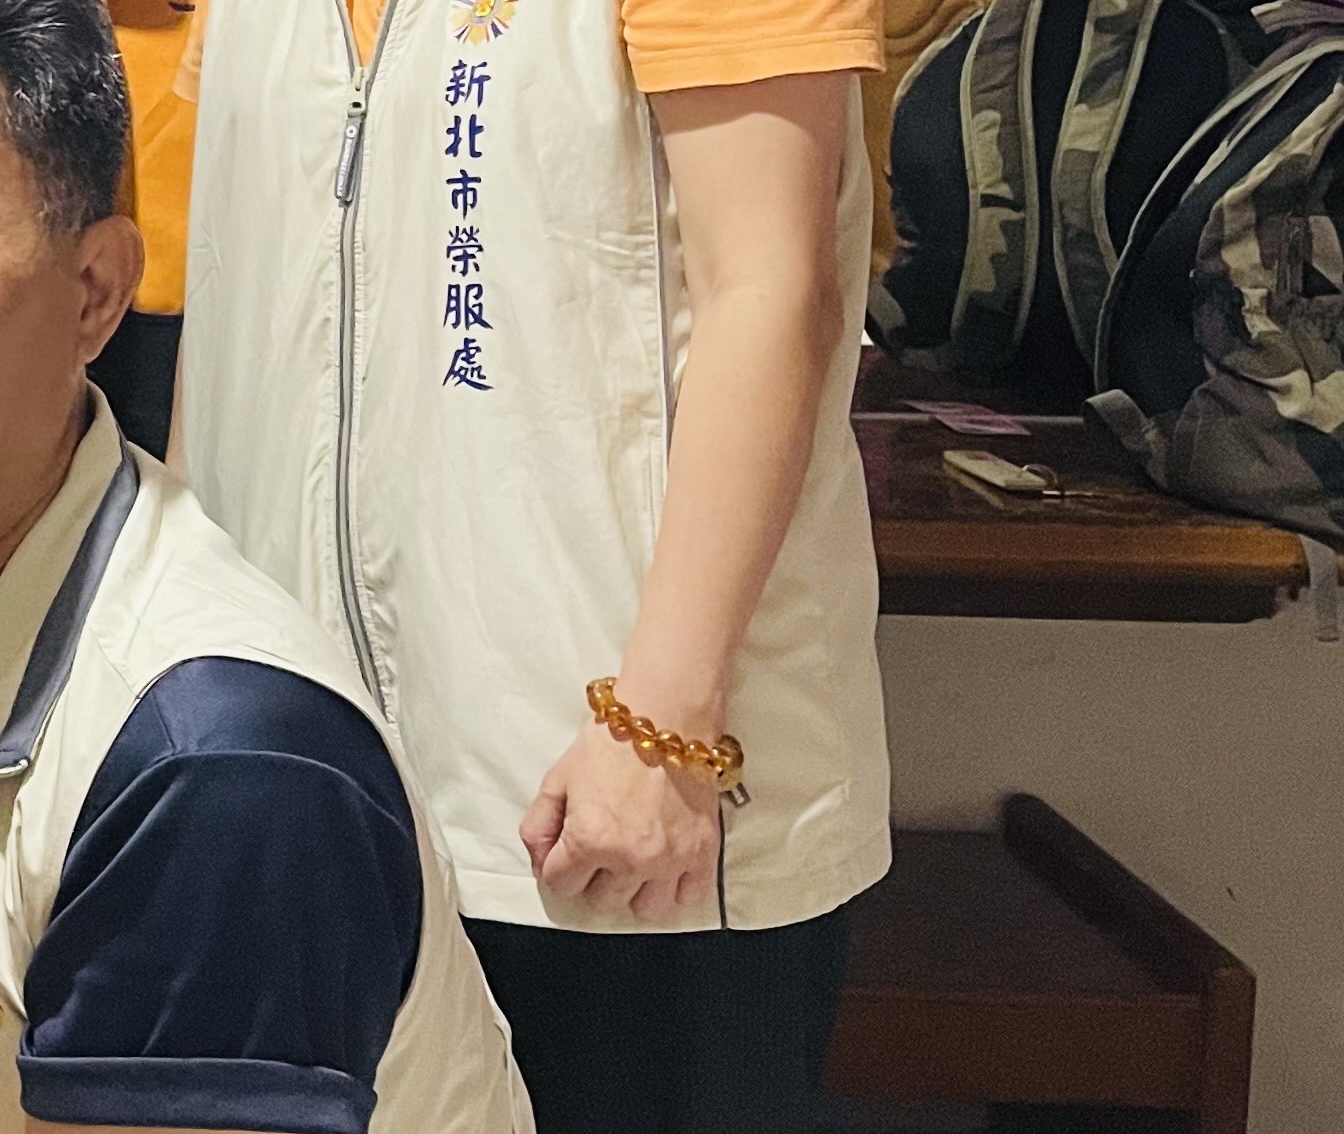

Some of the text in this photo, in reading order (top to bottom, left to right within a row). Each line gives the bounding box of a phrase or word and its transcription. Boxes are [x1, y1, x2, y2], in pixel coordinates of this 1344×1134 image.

[443, 59, 495, 391] 新北市榮服處
